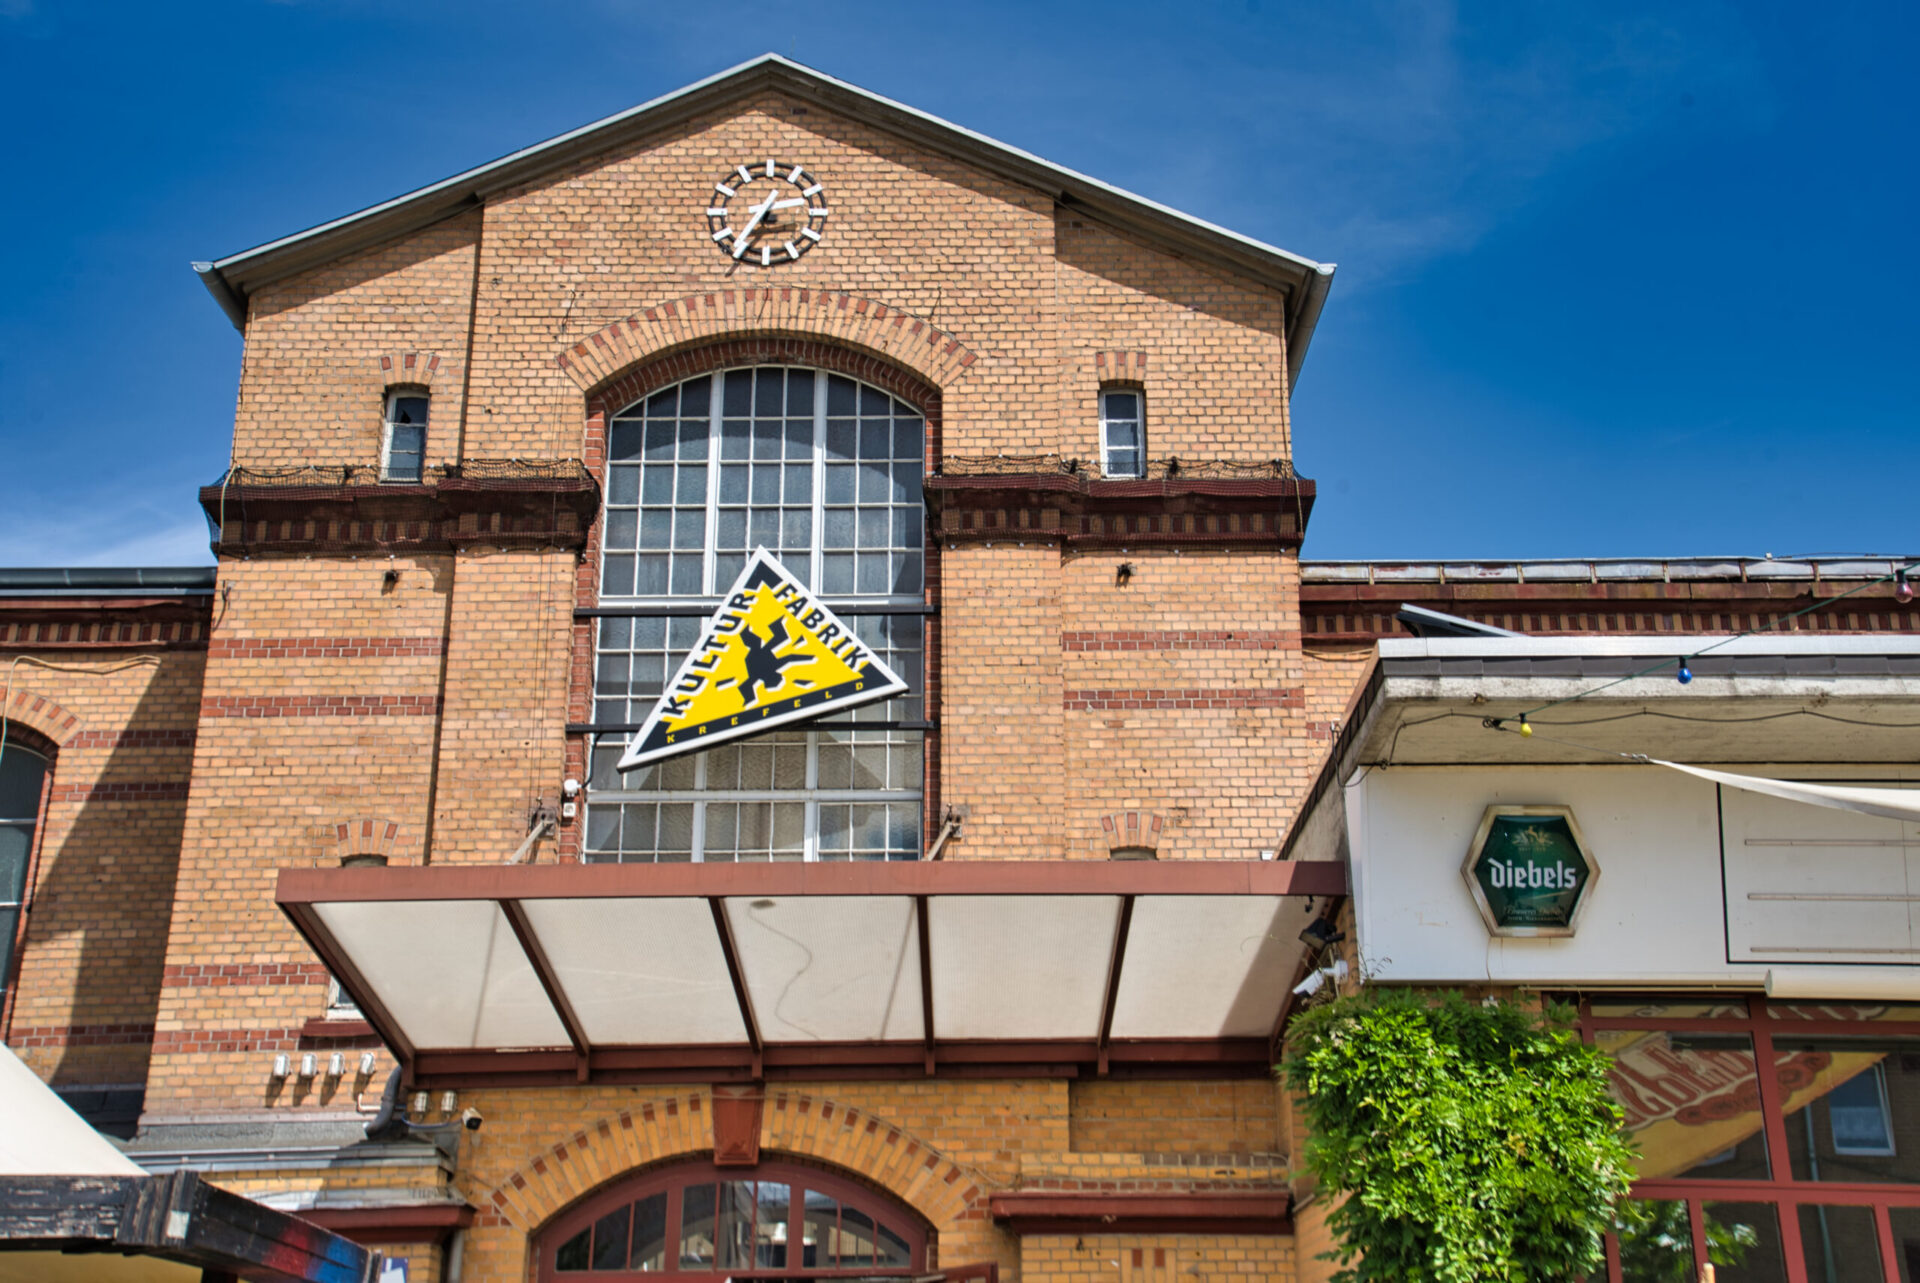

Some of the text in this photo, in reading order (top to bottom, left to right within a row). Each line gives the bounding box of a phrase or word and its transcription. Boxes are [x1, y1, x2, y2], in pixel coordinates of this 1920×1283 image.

[661, 593, 755, 716] KULTUR
[774, 584, 868, 669] FABRIK
[666, 681, 864, 744] KREFELD
